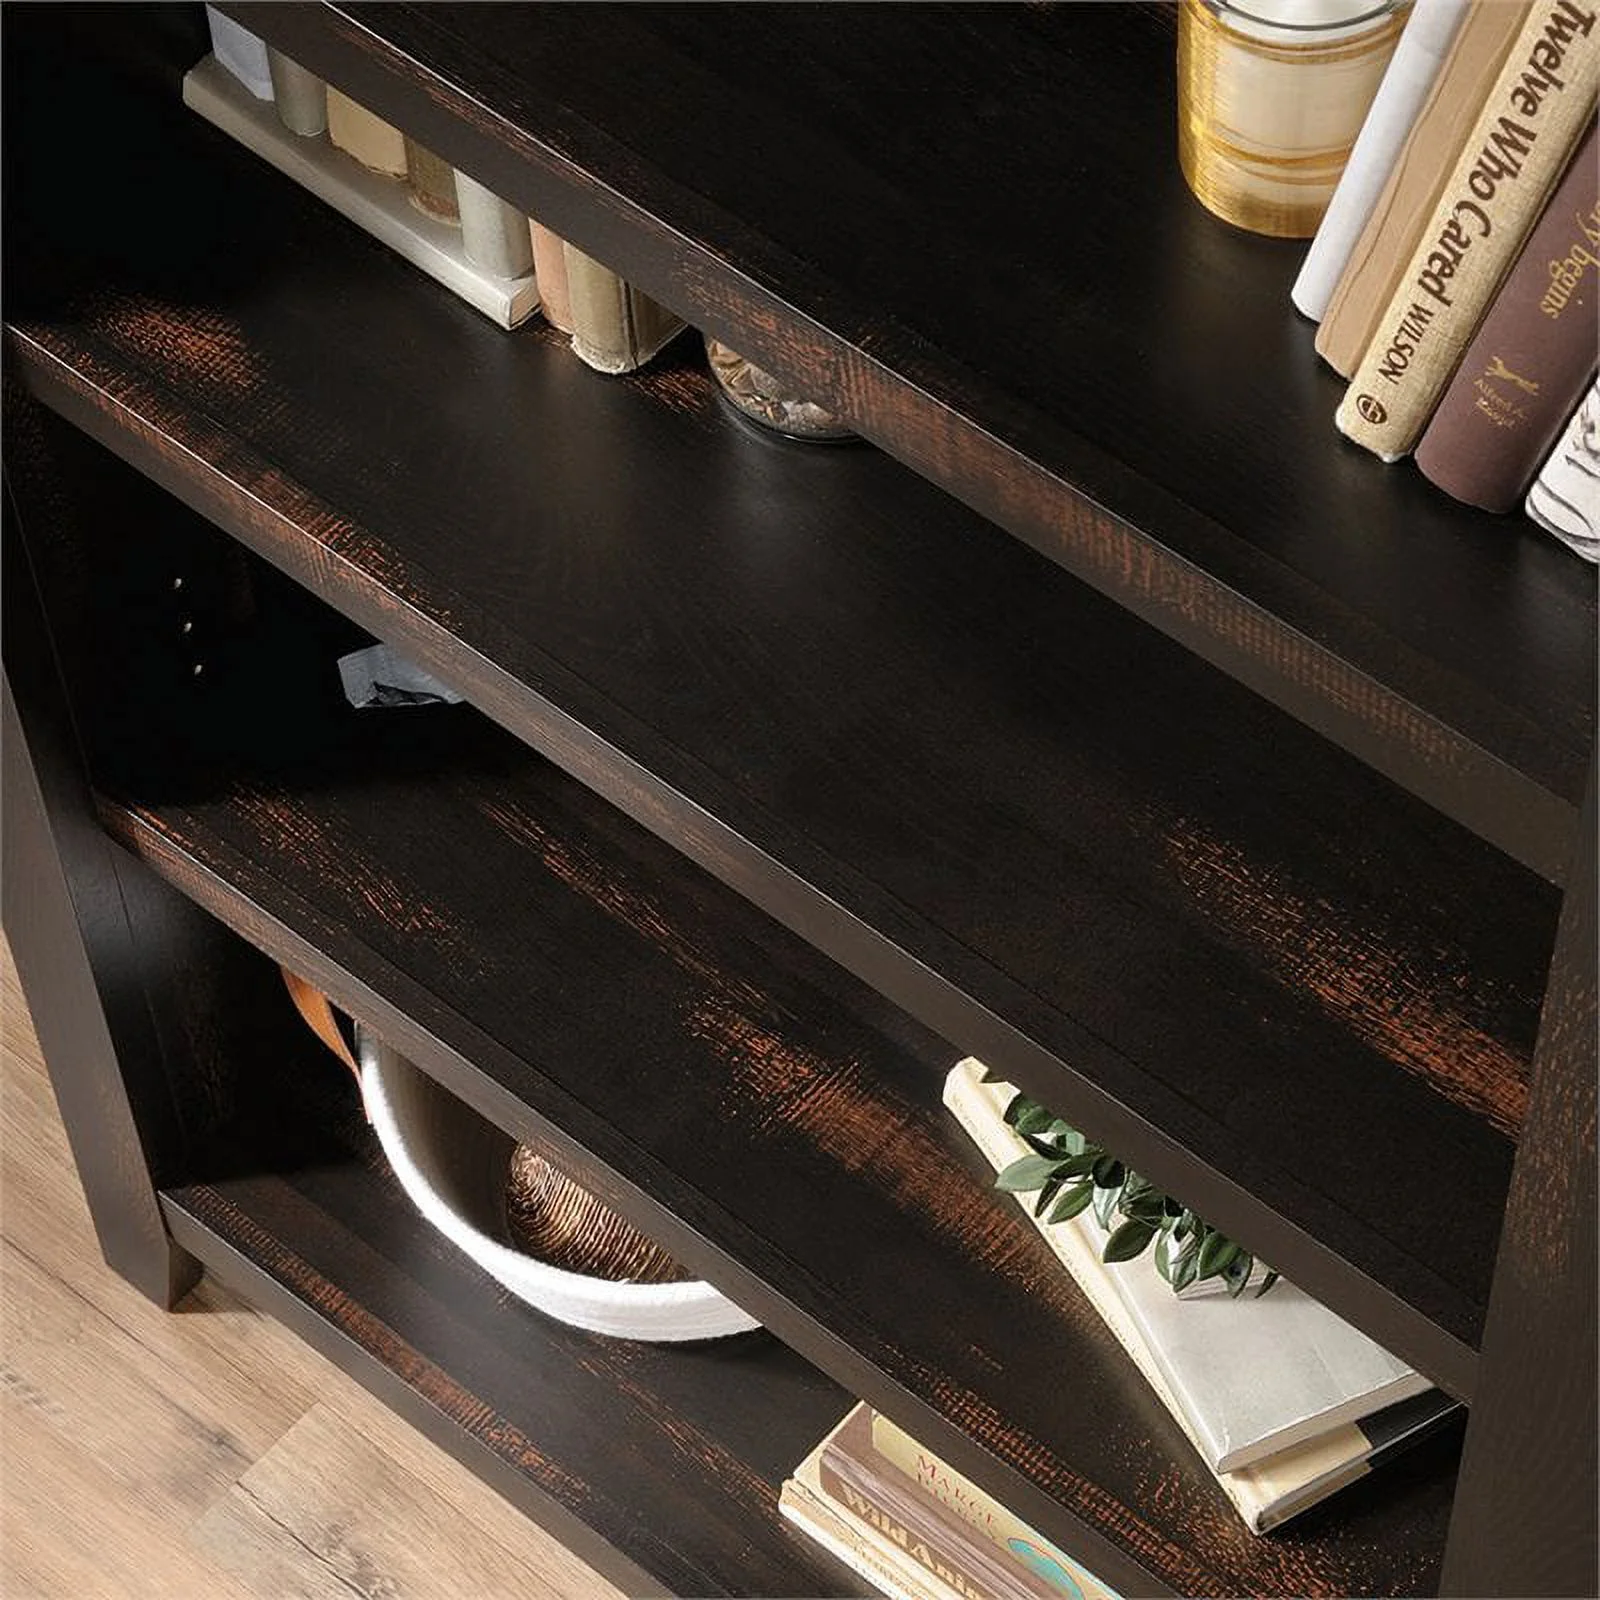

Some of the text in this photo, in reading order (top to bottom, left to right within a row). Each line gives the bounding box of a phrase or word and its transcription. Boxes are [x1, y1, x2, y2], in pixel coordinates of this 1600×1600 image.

[1378, 1, 1596, 385] Twelve Who Cared WILSON
[1541, 244, 1599, 319] begins
